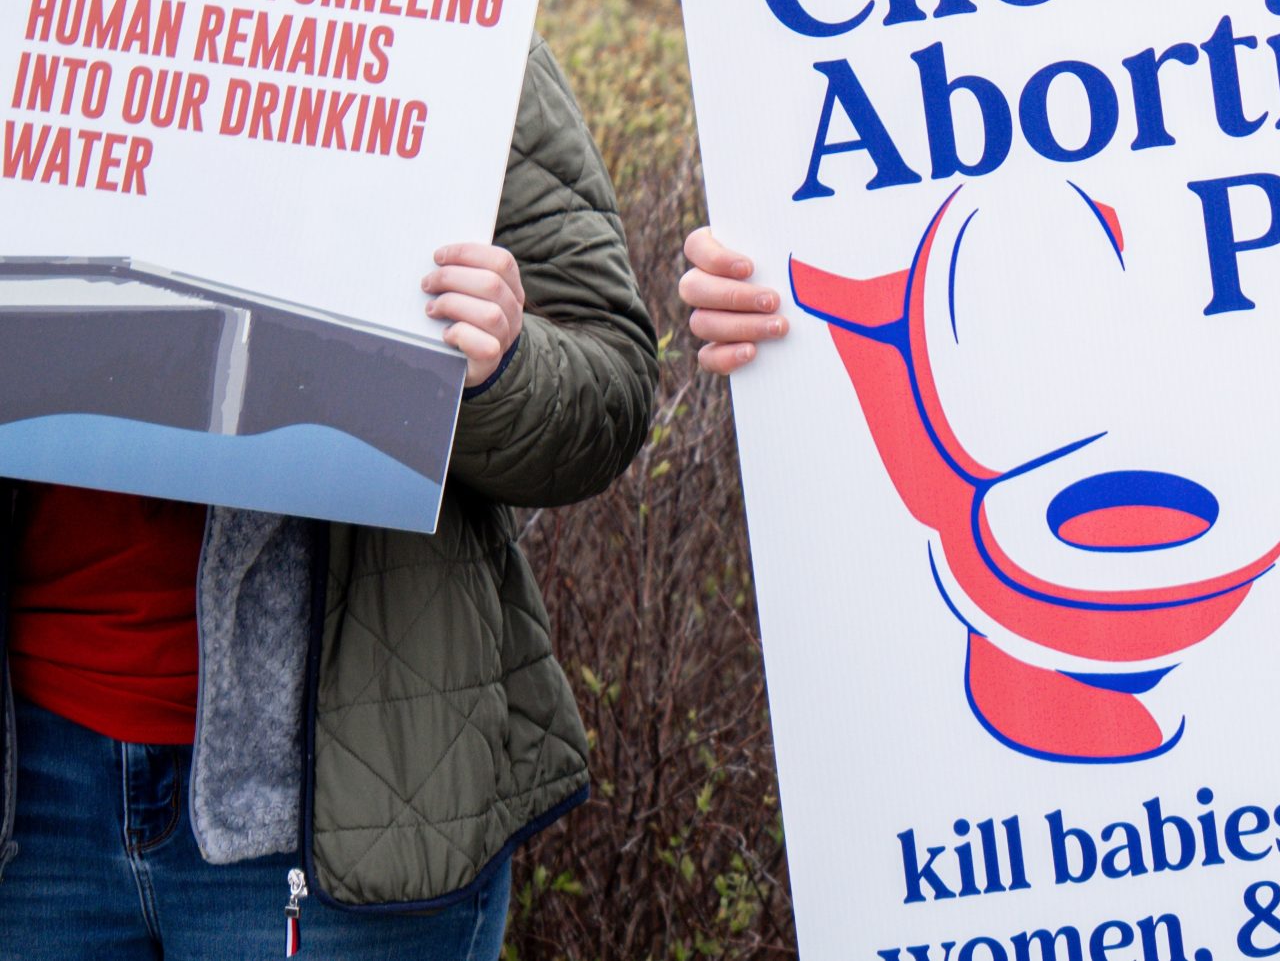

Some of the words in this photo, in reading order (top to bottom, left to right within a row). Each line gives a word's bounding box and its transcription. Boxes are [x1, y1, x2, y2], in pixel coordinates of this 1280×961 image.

[194, 5, 394, 84] REMAINS
[12, 52, 112, 119] INTO
[122, 66, 209, 132] OUR
[220, 79, 427, 159] DRINKING
[3, 120, 153, 195] WATER
[897, 815, 1031, 904] kill
[877, 914, 1213, 961] men
